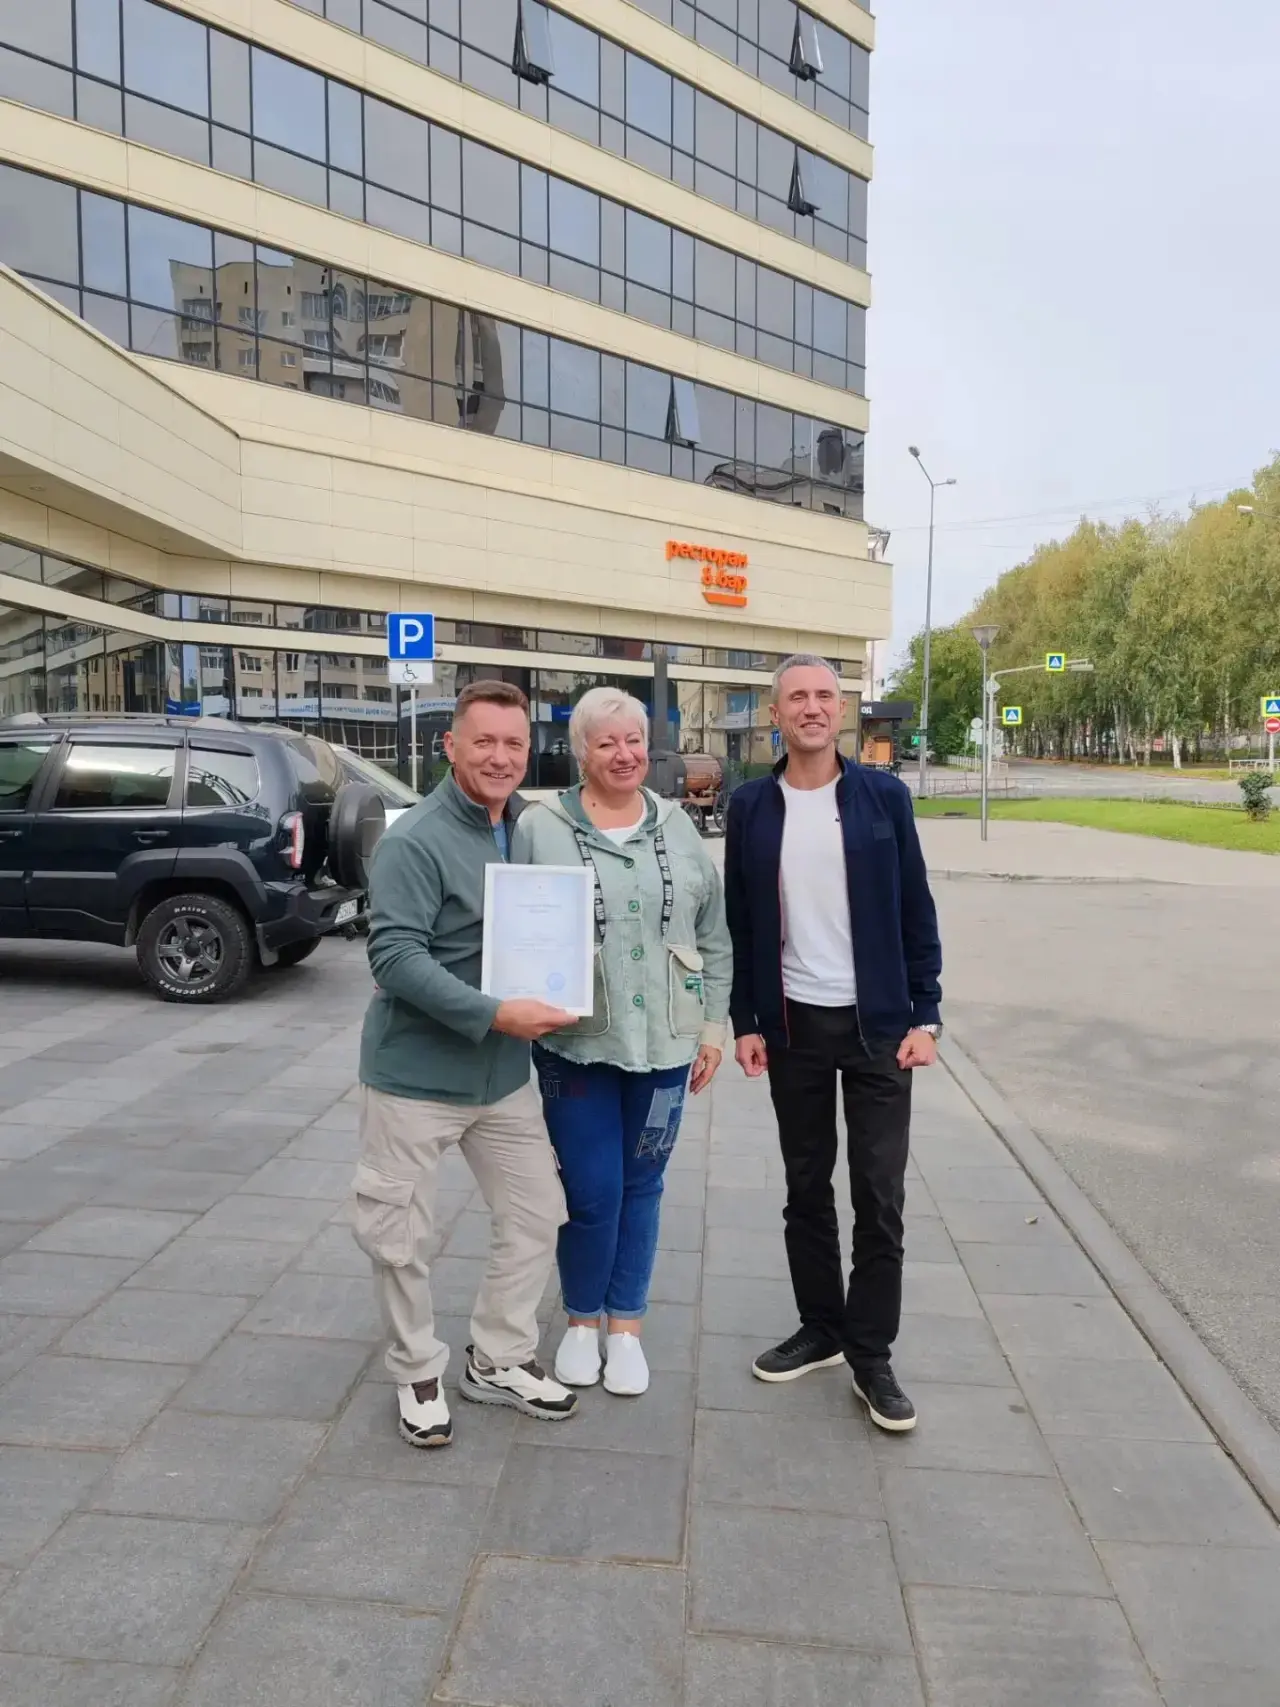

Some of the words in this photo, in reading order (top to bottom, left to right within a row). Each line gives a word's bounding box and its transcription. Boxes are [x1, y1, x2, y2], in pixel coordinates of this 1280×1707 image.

[666, 540, 748, 569] ресторан
[715, 567, 748, 594] бар
[399, 618, 424, 655] P
